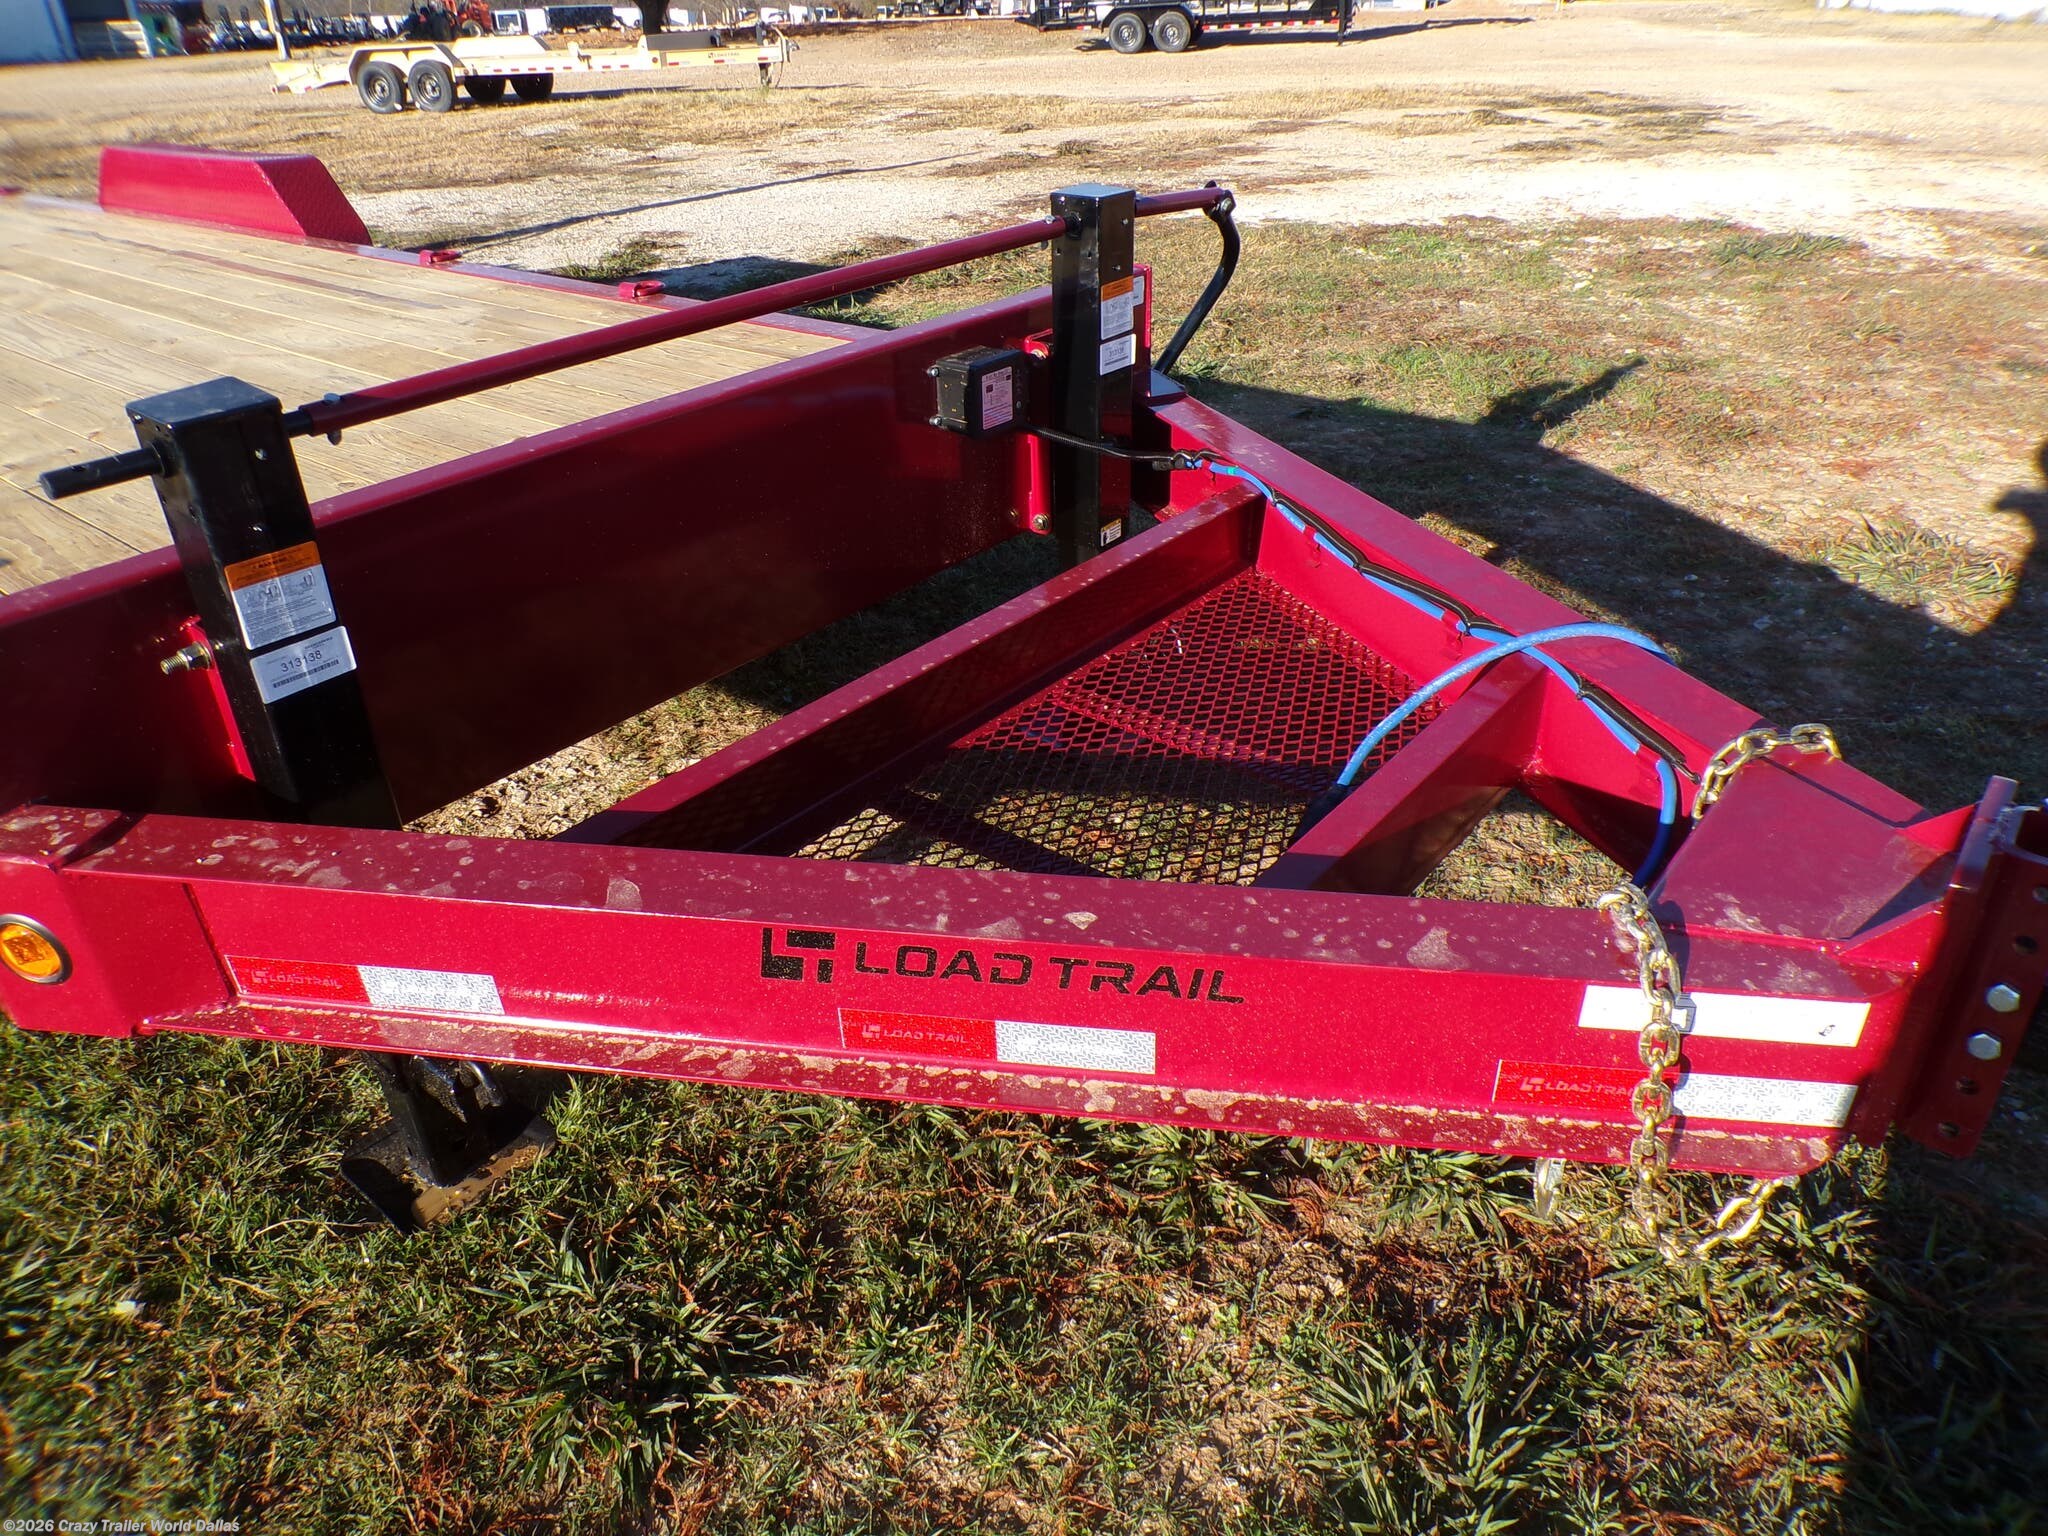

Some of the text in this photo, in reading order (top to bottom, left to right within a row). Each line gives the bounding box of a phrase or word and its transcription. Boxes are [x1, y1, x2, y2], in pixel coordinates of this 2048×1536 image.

[280, 650, 323, 673] 313138
[855, 941, 1033, 986] LOAD
[1049, 956, 1245, 1004] TRAIL
